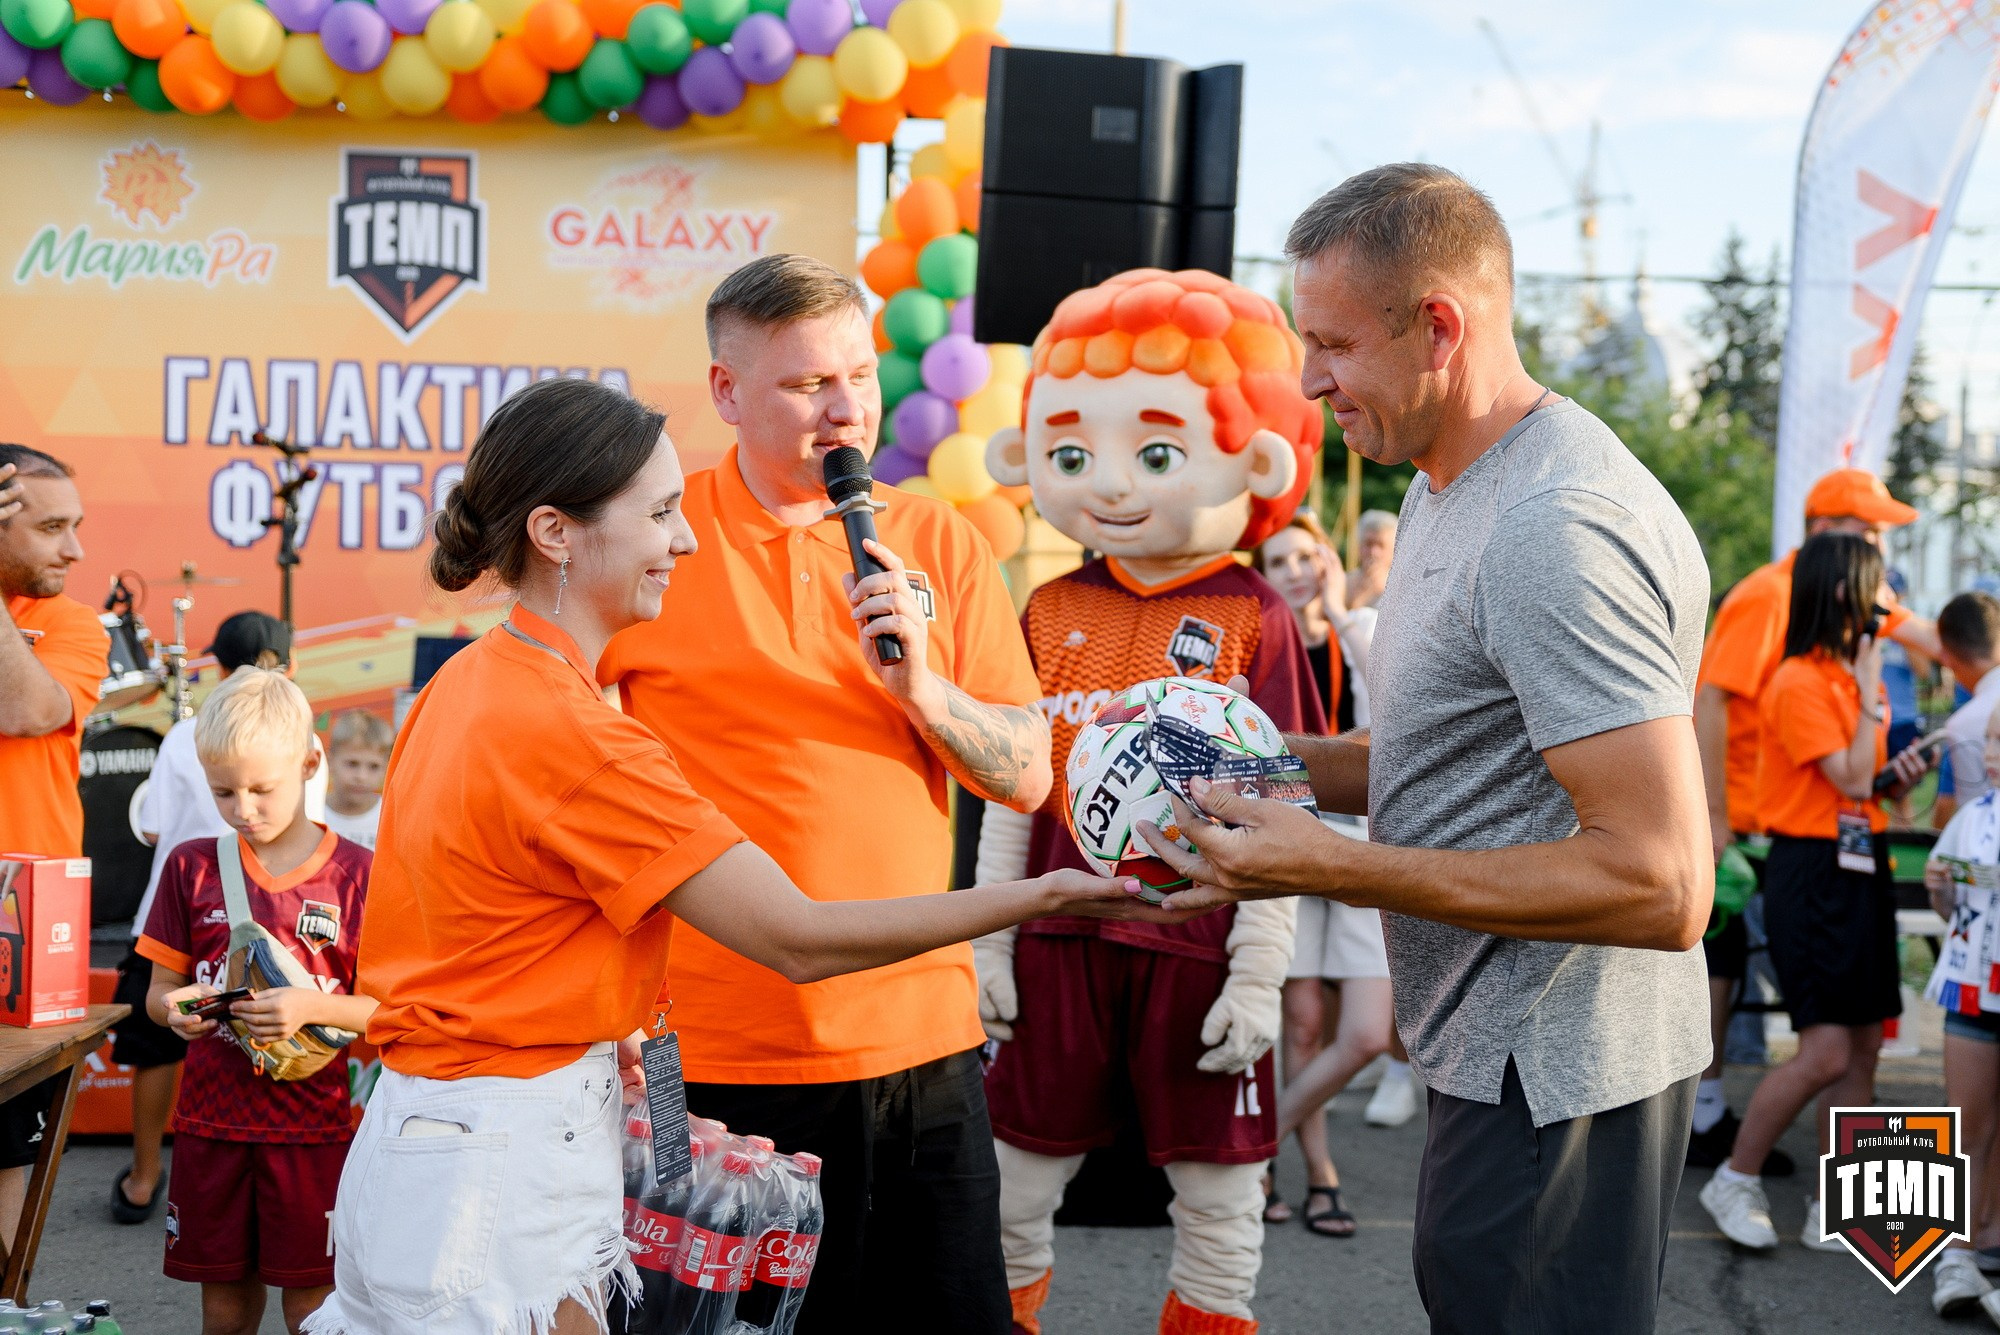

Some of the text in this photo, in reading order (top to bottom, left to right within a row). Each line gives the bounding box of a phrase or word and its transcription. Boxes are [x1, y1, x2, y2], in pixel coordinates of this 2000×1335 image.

[344, 200, 474, 275] ТЕМП
[551, 209, 771, 253] GALAXY
[1187, 694, 1201, 725] GALAXY
[1082, 731, 1152, 850] SELECT
[302, 915, 337, 940] ТЕМП
[766, 1237, 817, 1264] Cola
